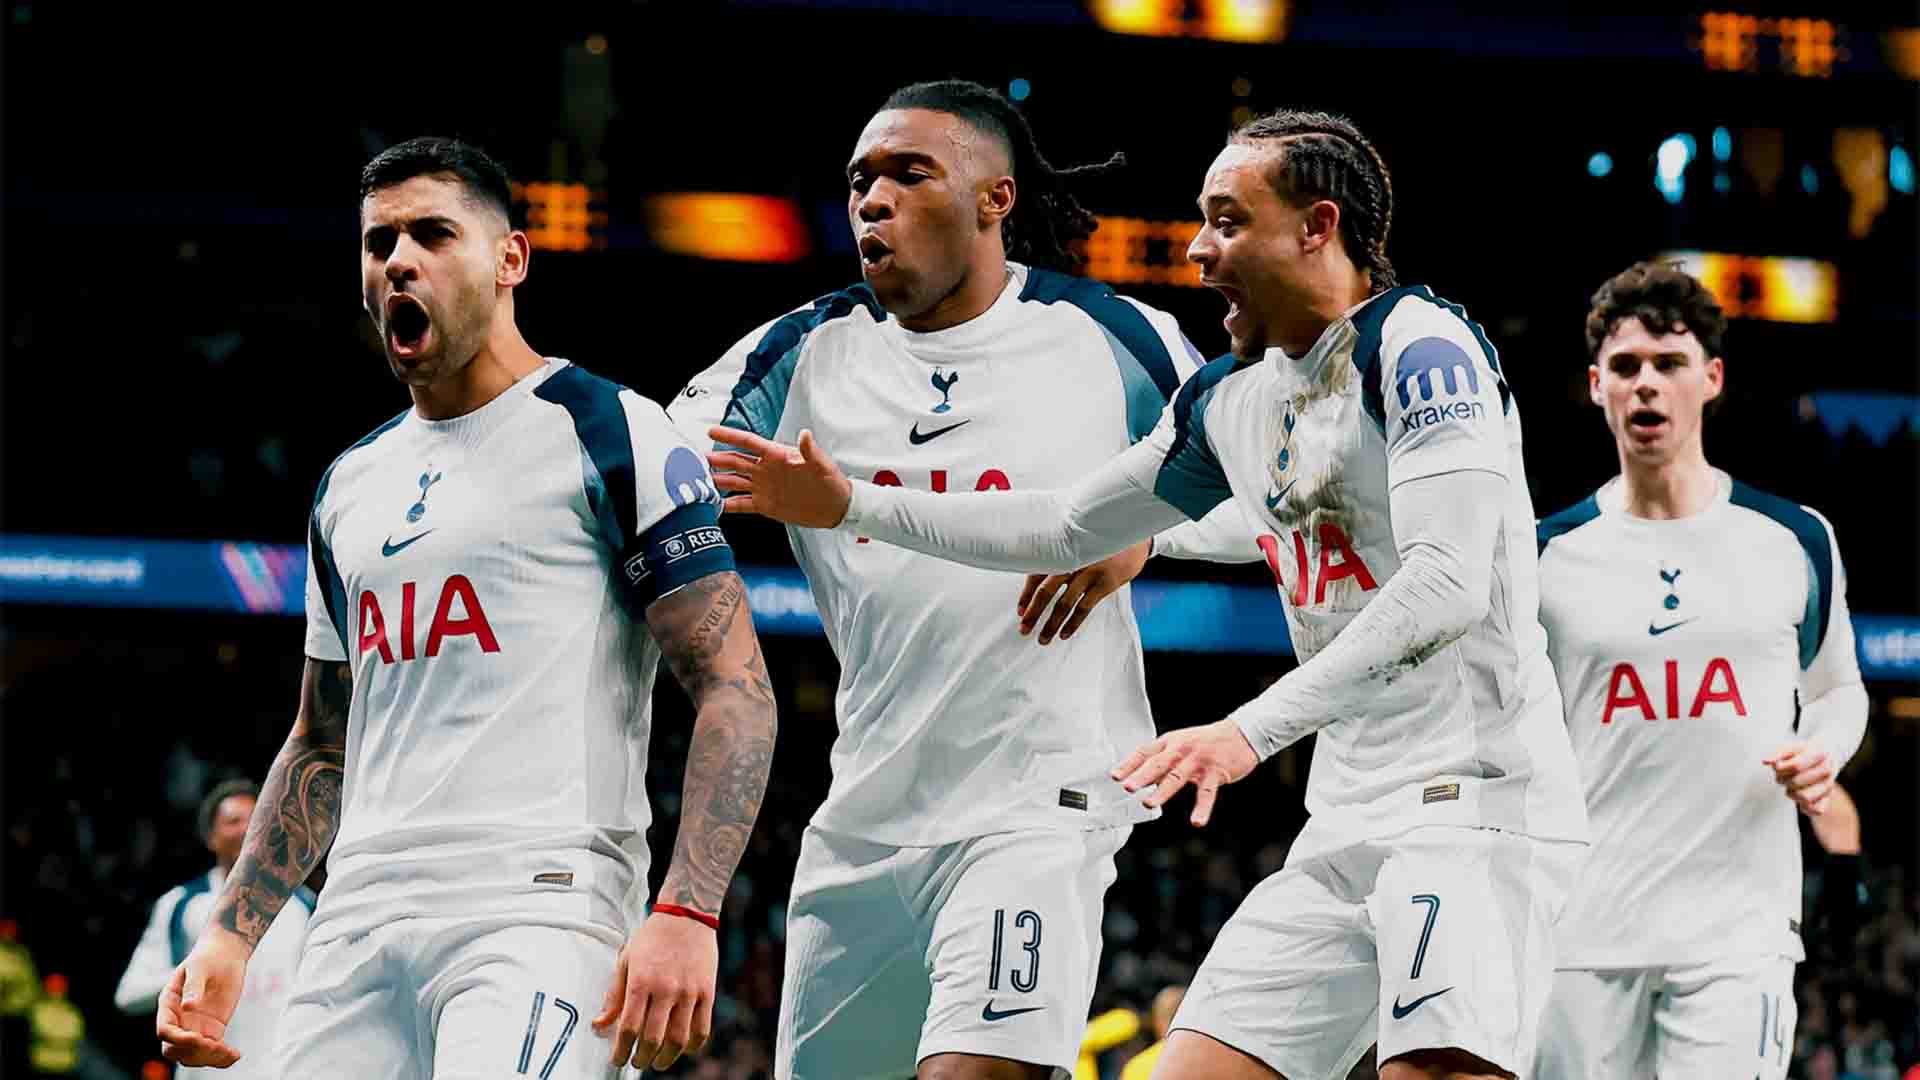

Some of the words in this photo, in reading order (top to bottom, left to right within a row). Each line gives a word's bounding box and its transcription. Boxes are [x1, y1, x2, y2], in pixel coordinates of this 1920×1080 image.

[1401, 401, 1487, 432] kraken
[358, 574, 501, 664] AIA
[1602, 657, 1747, 724] AIA
[988, 910, 1042, 993] 13
[1410, 894, 1441, 979] 7
[517, 991, 578, 1080] 17
